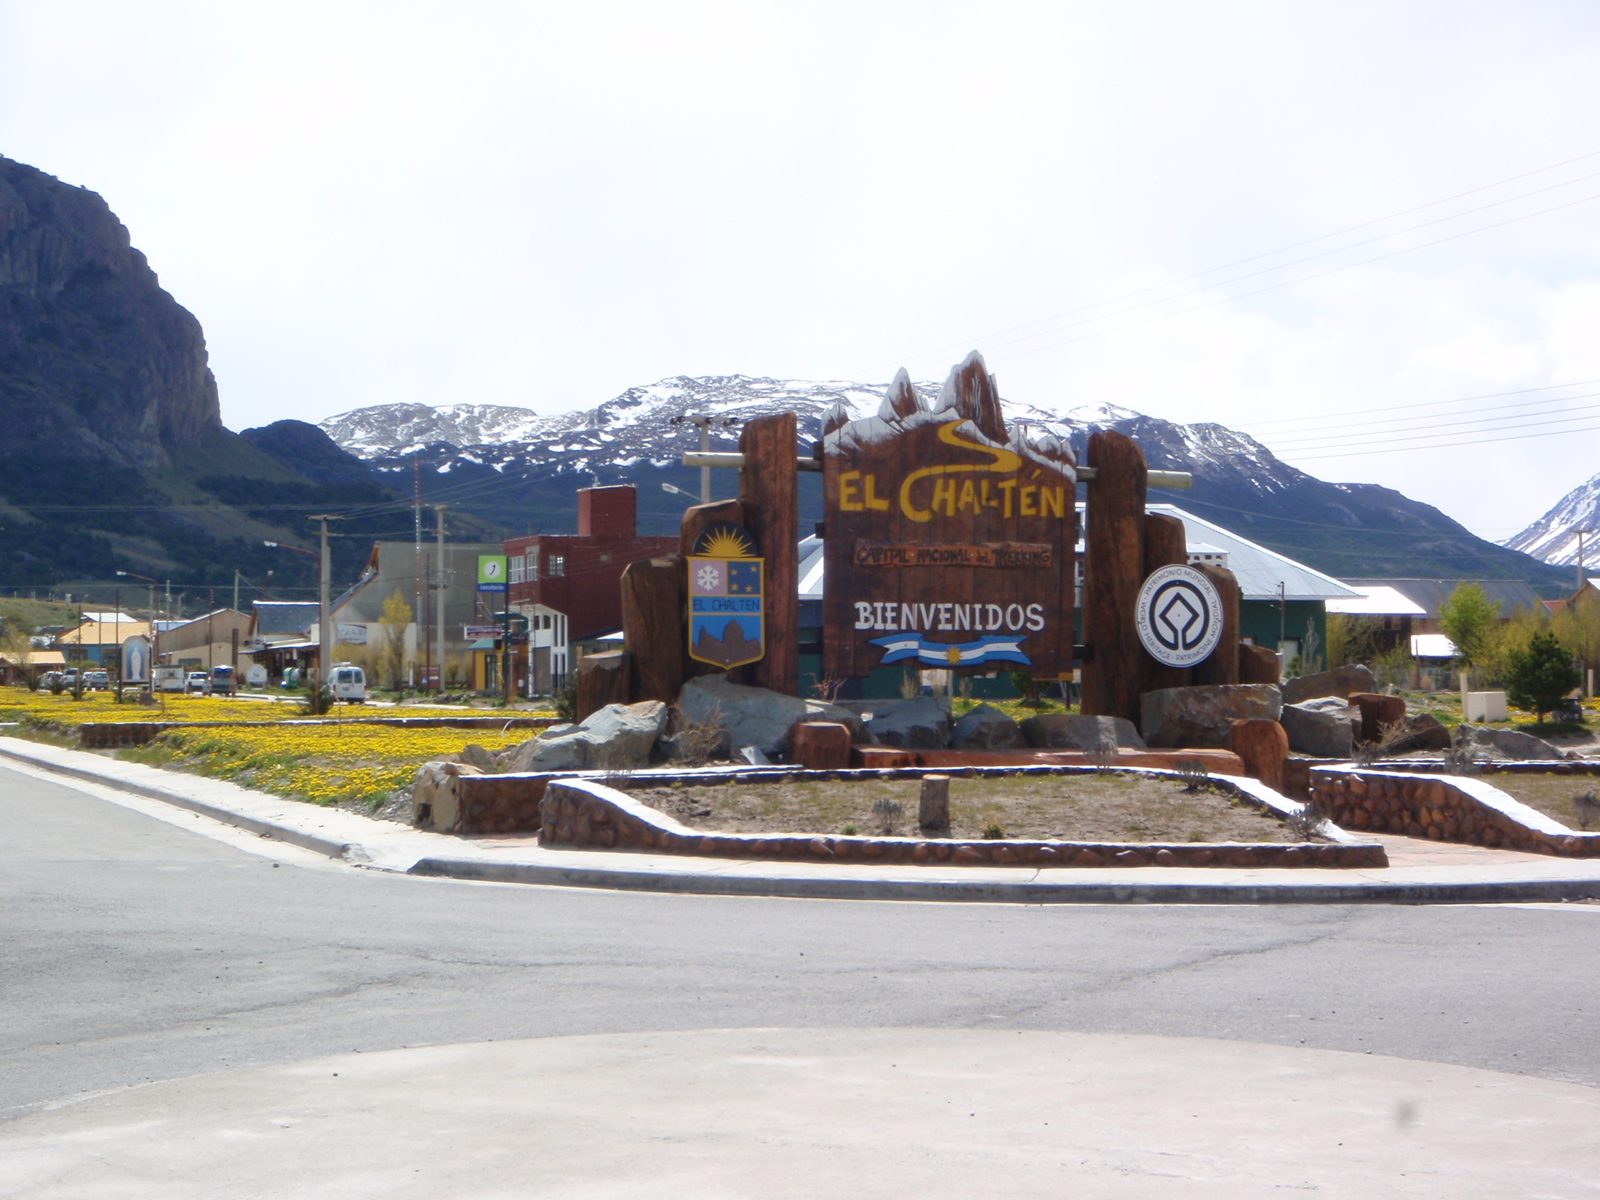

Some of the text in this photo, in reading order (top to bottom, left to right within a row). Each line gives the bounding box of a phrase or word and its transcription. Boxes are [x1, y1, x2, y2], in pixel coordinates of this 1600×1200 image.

[839, 419, 1064, 523] EL CHALTÉN
[1145, 568, 1212, 596] PATRIMONIO MUNDIAL
[693, 600, 707, 611] EL
[854, 601, 1045, 631] BIENVENIDOS
